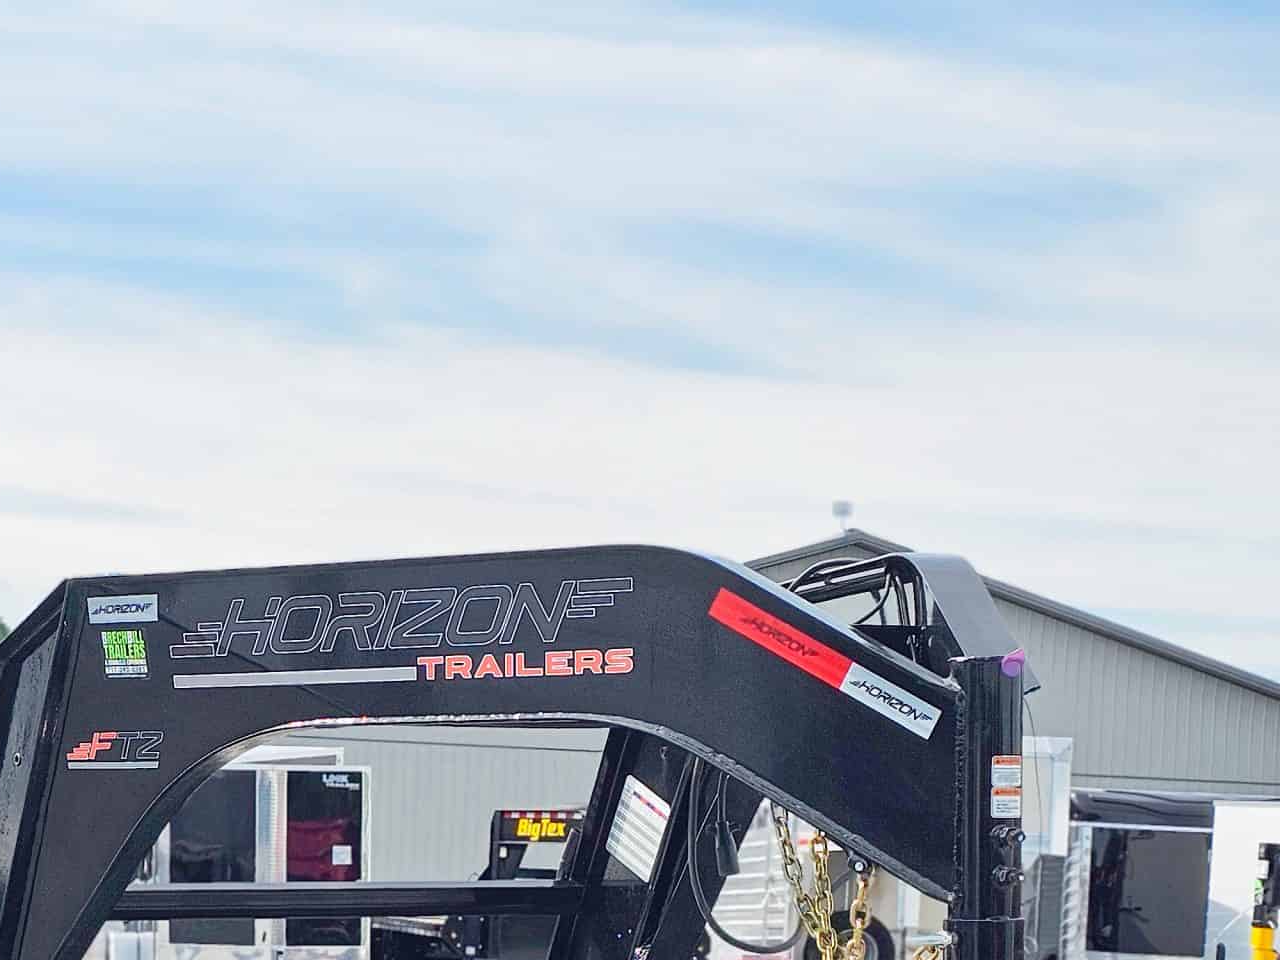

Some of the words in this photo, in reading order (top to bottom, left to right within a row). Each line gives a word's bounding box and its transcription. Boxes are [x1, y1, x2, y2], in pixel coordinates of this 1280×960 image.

[216, 580, 576, 656] HORIZON
[101, 629, 144, 644] BRECHBILL
[104, 644, 146, 659] TRAILERS
[750, 617, 812, 657] HORIZON
[416, 648, 634, 681] TRAILERS
[858, 680, 923, 721] HORIZON
